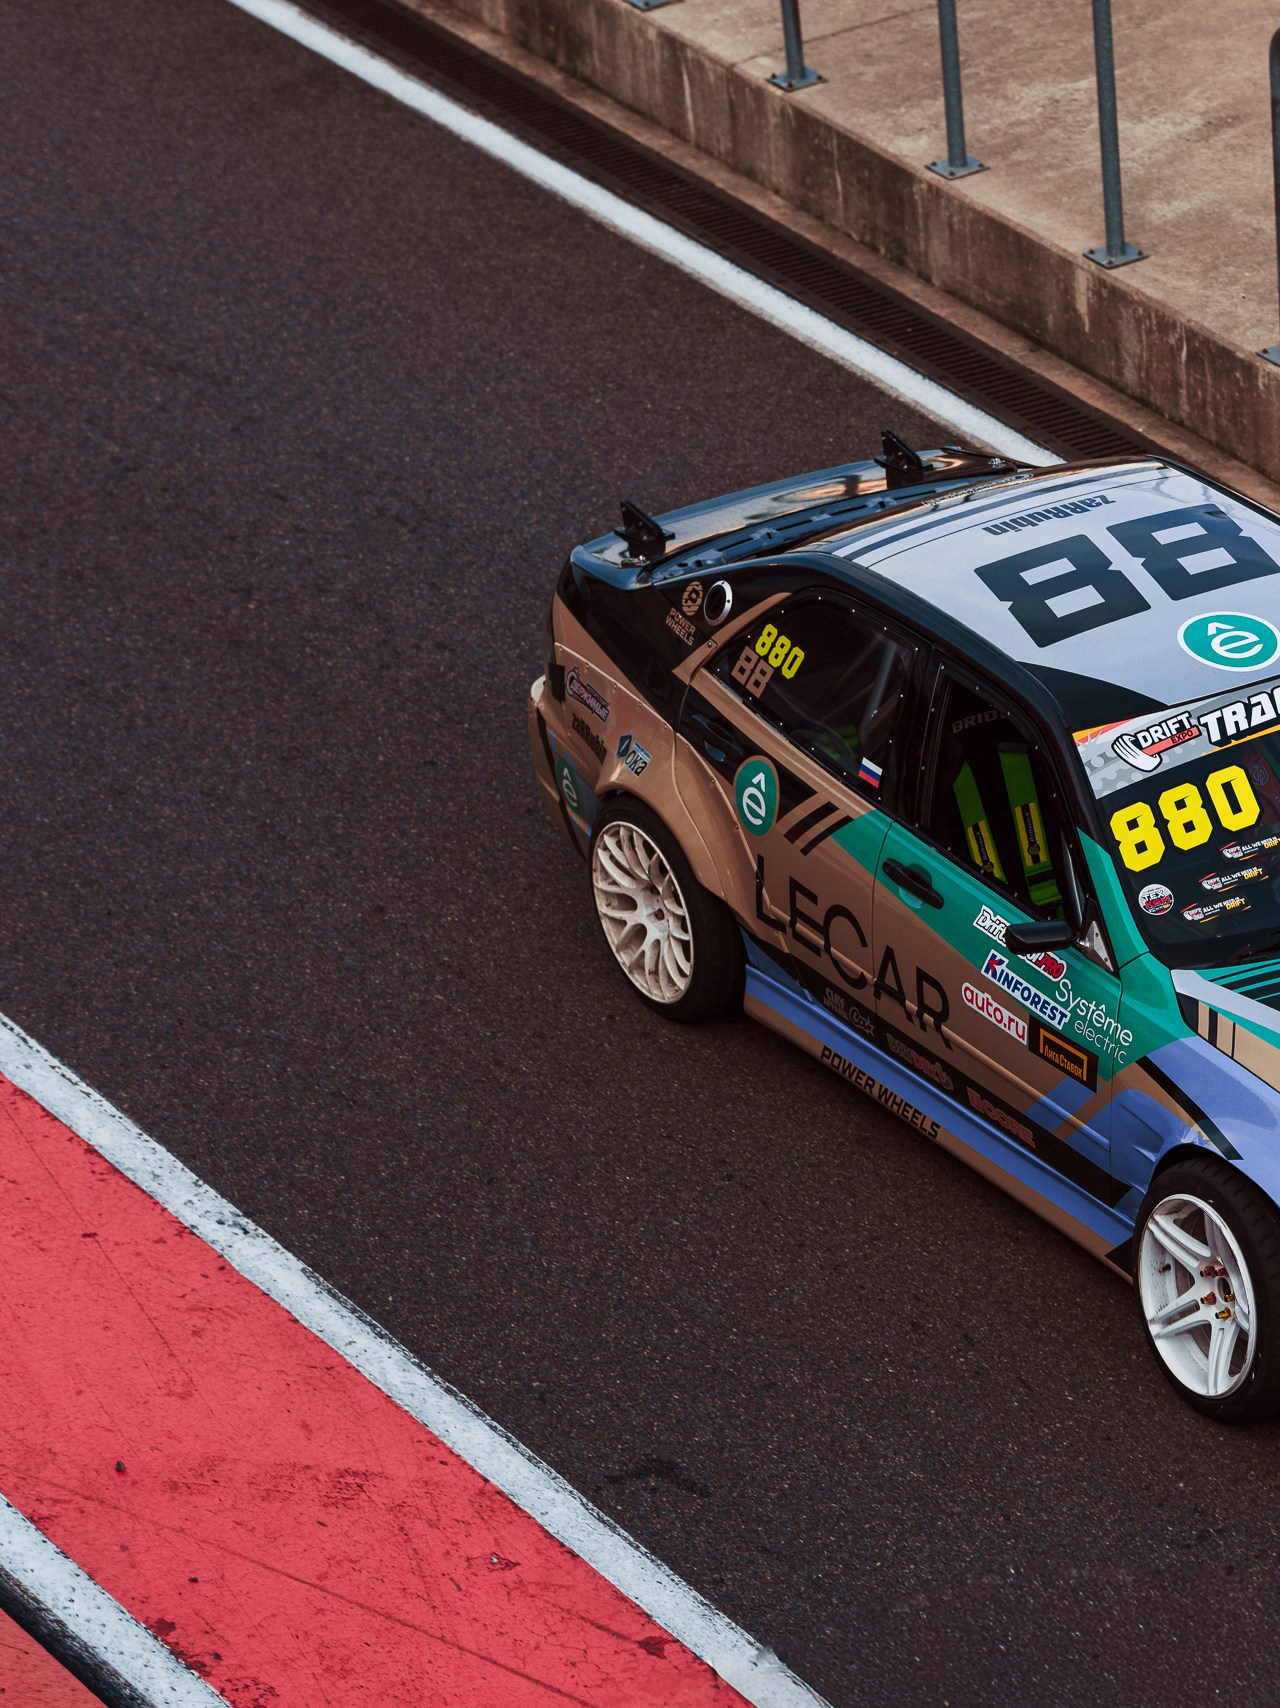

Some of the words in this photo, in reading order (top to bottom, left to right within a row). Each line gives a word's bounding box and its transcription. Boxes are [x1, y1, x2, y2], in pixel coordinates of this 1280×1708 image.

[665, 616, 695, 646] WHEELS
[670, 607, 696, 634] POWER
[731, 645, 774, 699] 88
[755, 624, 805, 679] 880
[951, 710, 1008, 734] BRID
[1136, 713, 1191, 749] DRIFT
[1171, 730, 1194, 744] EXPO
[1109, 765, 1261, 872] 880
[1244, 868, 1263, 879] DRIFT
[1226, 898, 1245, 909] DRIFT
[756, 854, 954, 1051] LECAR
[963, 986, 1026, 1041] auto.ru
[984, 953, 1068, 1026] KINFOREST
[1055, 979, 1133, 1046] Systême
[1074, 1020, 1127, 1064] electric
[821, 1045, 876, 1094] POWER
[876, 1083, 941, 1139] WHEELS
